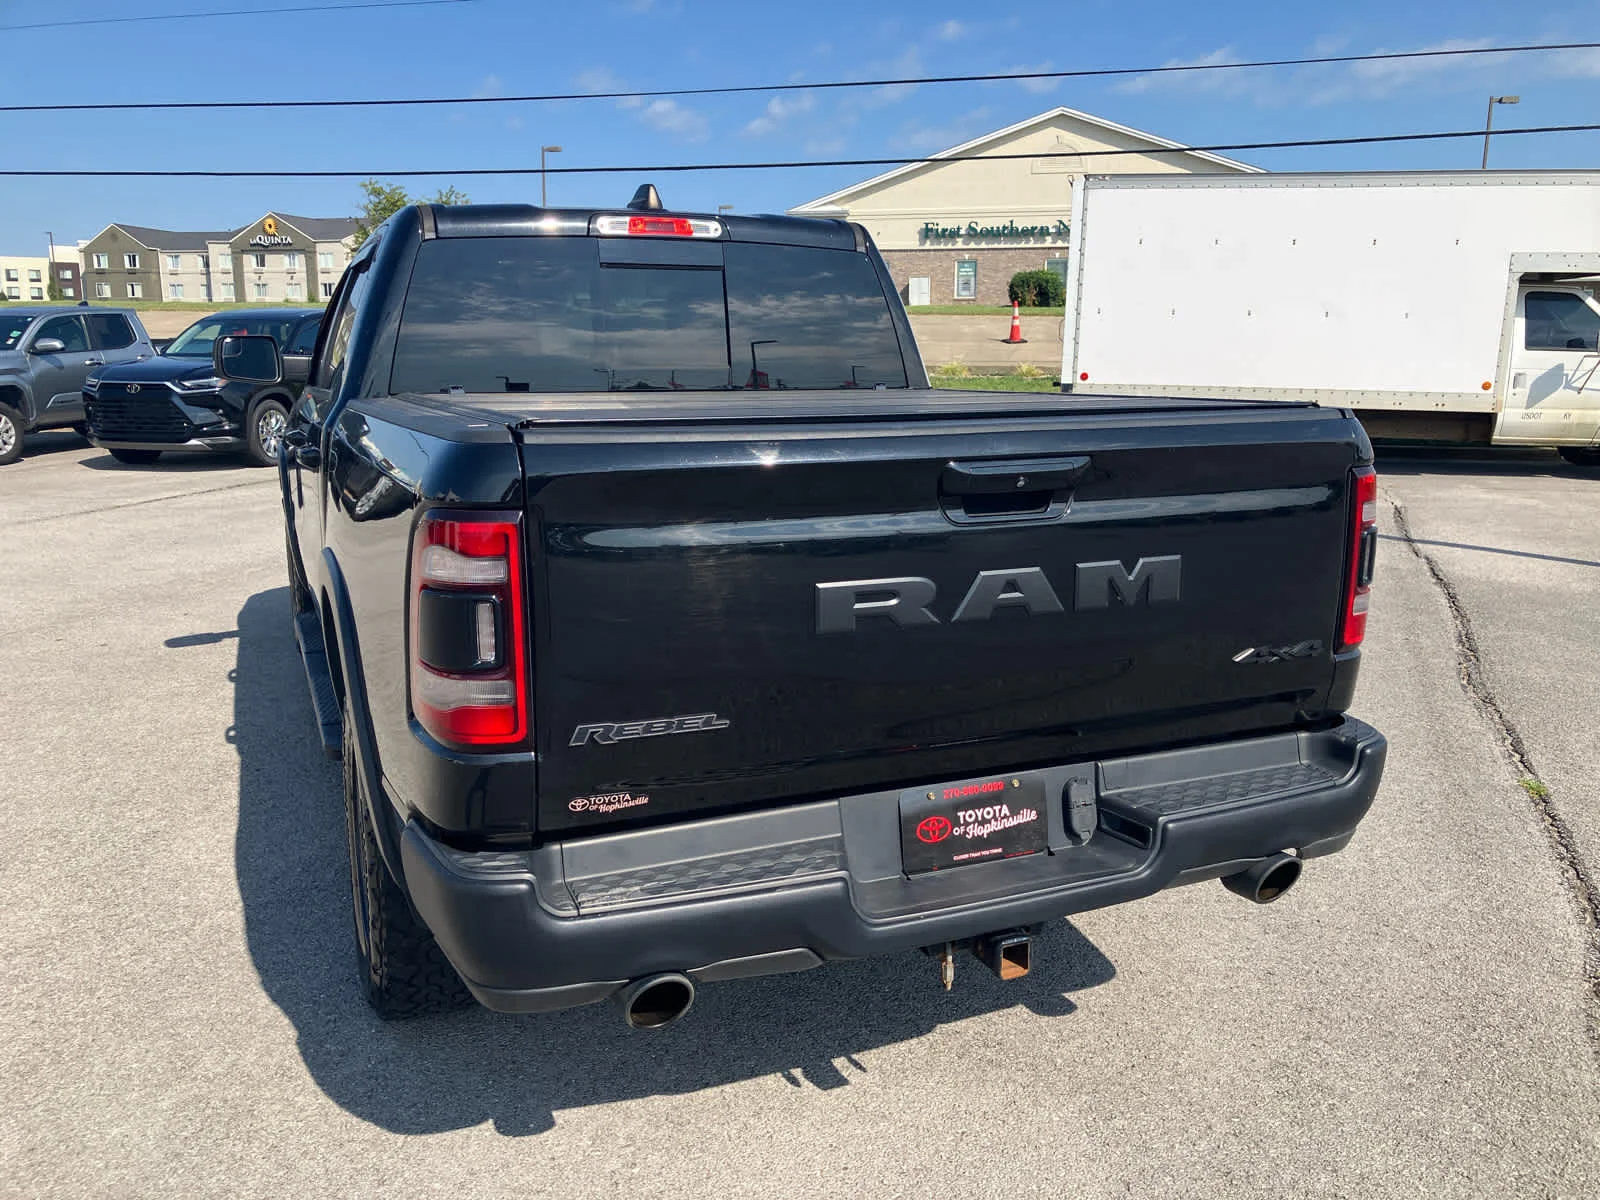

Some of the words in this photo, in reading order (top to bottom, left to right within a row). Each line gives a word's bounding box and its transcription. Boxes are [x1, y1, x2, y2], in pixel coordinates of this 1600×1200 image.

[923, 222, 962, 239] First
[967, 219, 1051, 238] Southern
[256, 235, 292, 246] QUINTA
[815, 554, 1182, 634] RAM
[568, 713, 730, 746] REBEL
[589, 793, 631, 804] TOYOTA
[599, 796, 649, 813] Hopkinsville
[953, 825, 966, 836] OF
[966, 808, 1038, 839] Hopkinsville
[957, 804, 1010, 824] TOYOTA
